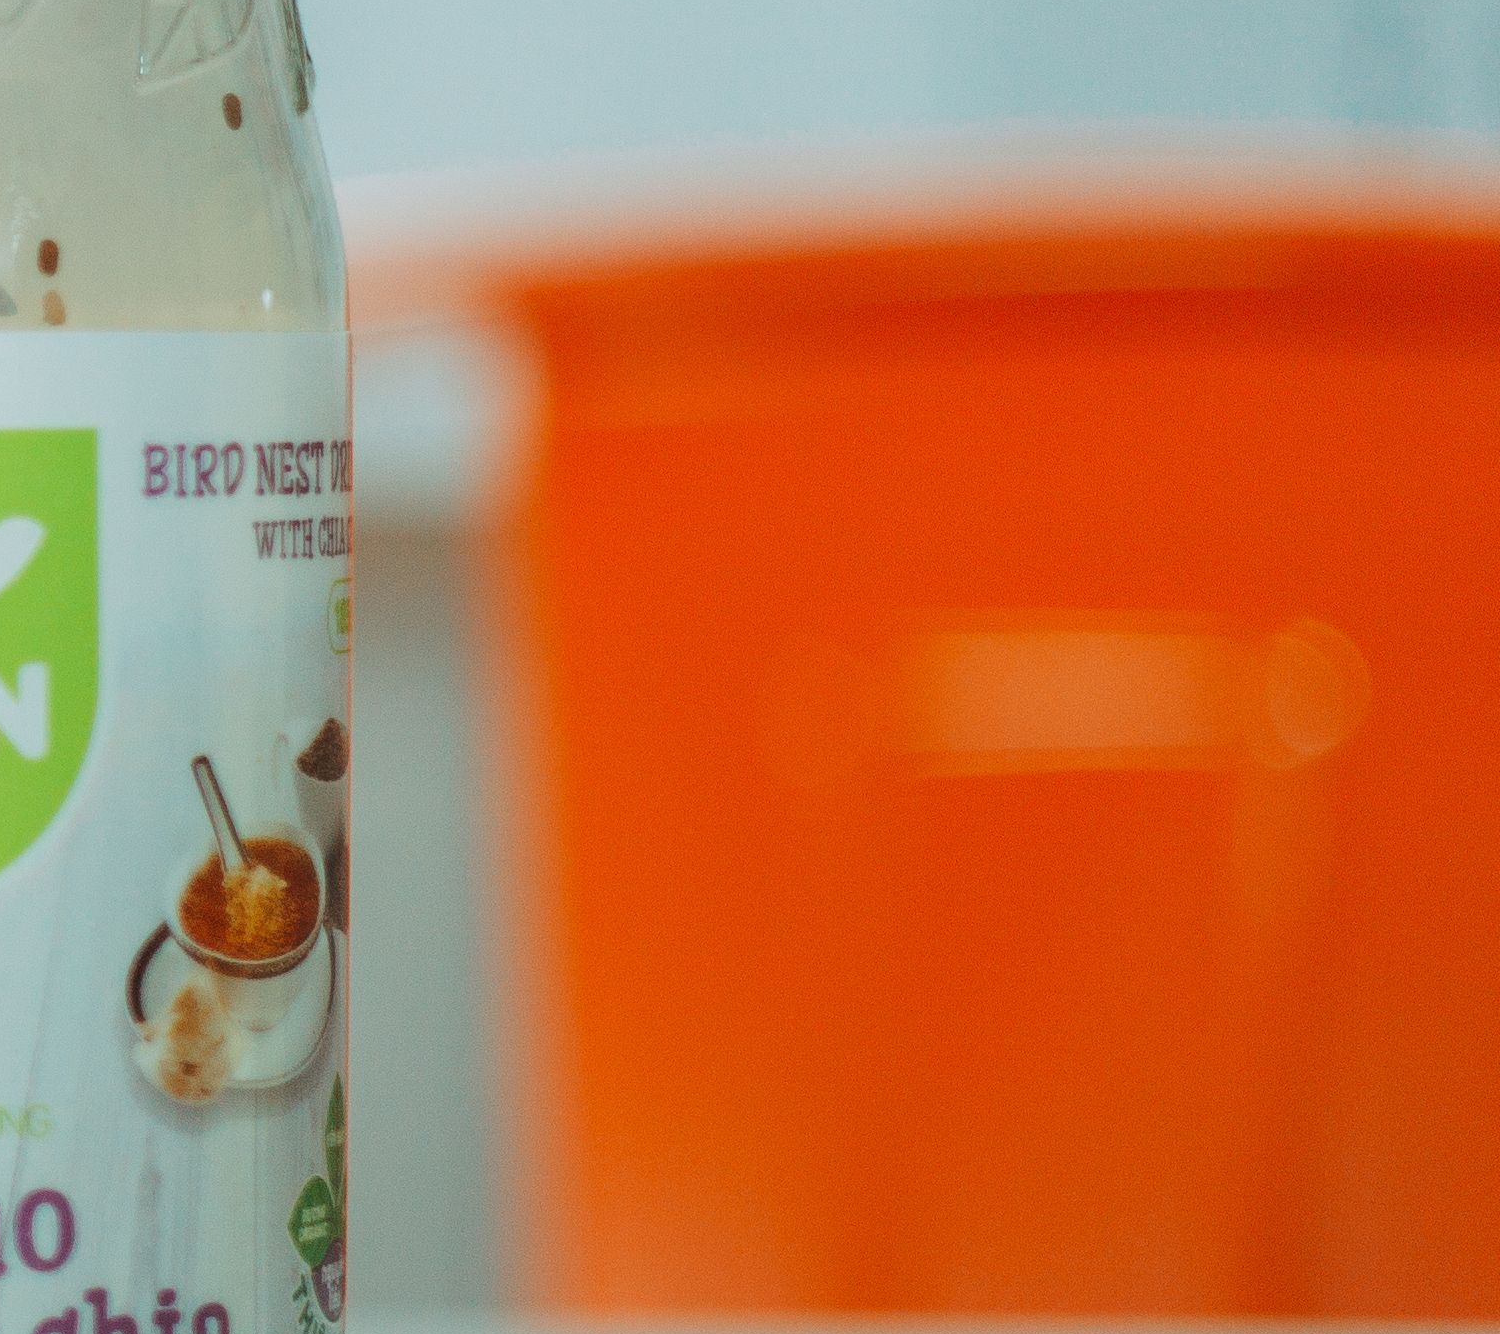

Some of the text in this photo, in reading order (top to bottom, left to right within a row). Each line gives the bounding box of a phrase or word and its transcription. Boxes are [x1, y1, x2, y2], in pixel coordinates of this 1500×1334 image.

[142, 441, 244, 499] BIRD
[254, 440, 325, 497] NEST
[252, 517, 314, 560] WITH
